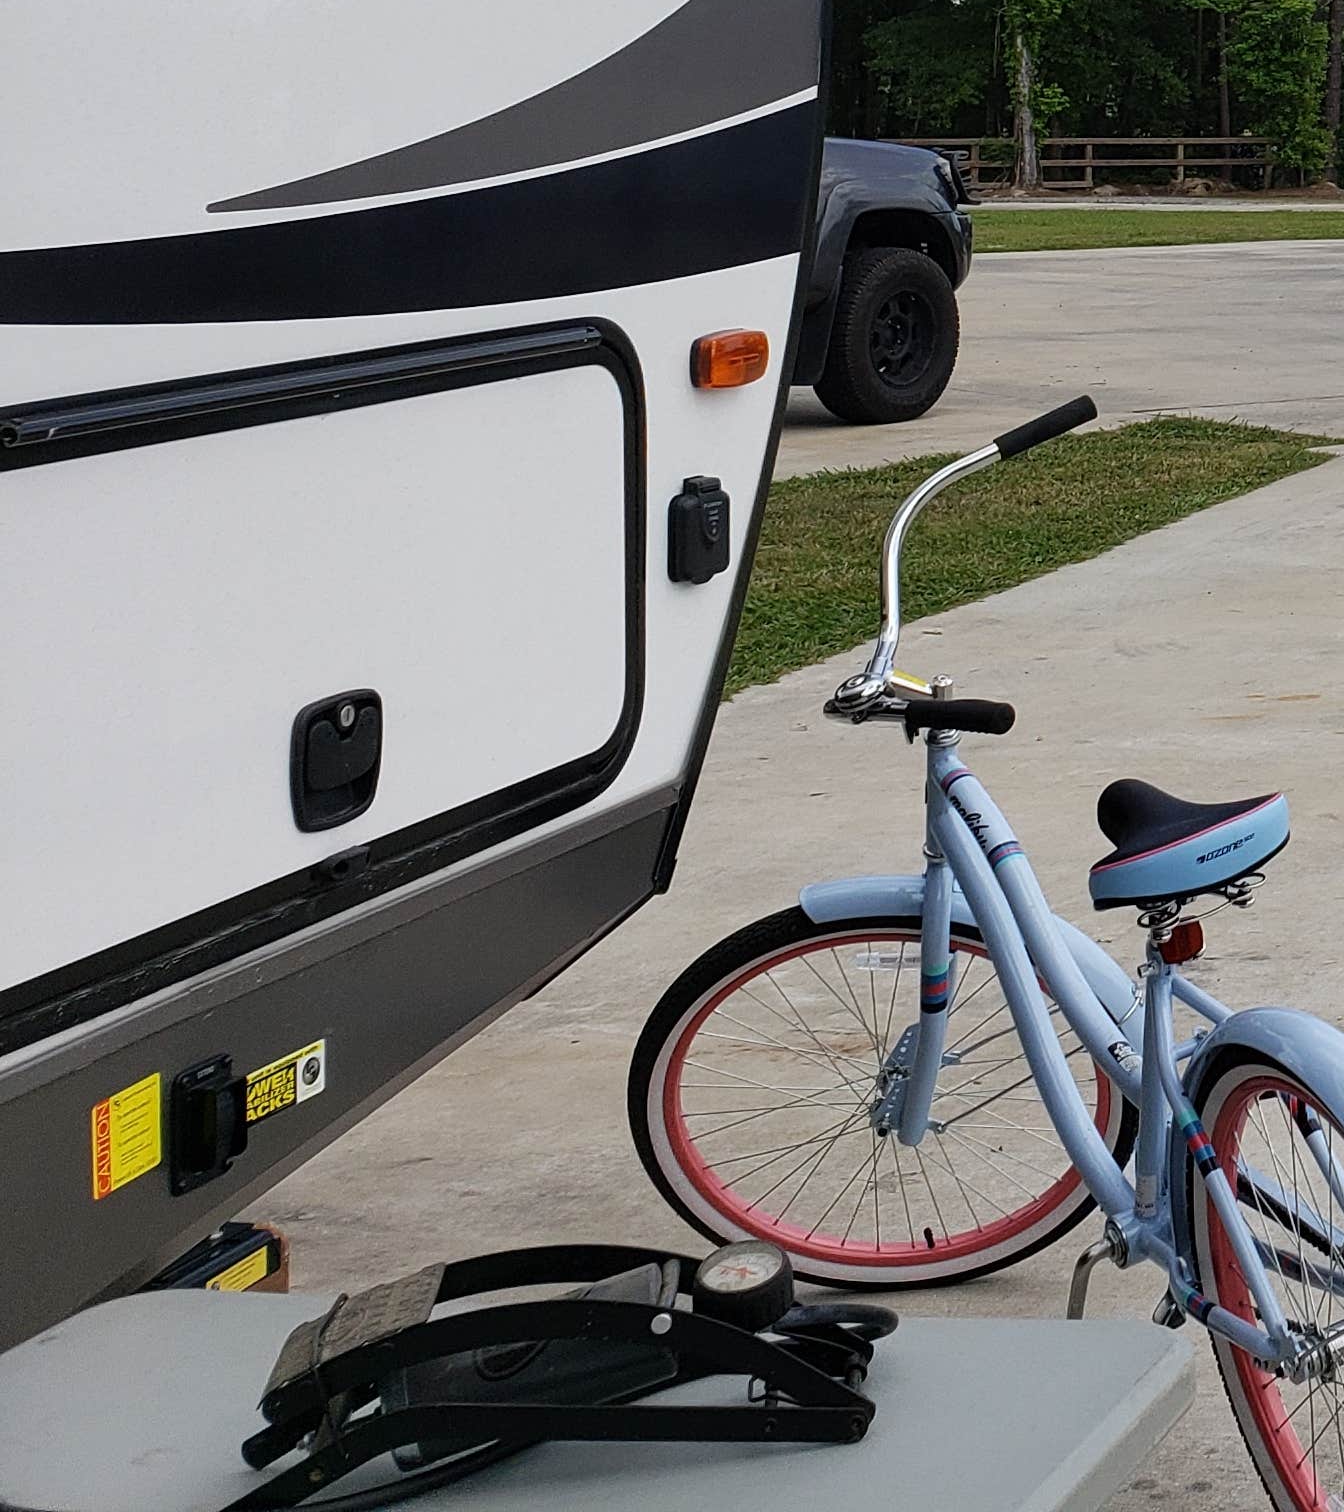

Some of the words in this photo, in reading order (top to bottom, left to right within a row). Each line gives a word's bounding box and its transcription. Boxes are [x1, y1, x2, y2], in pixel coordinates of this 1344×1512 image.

[247, 1067, 295, 1102] OWER
[247, 1089, 295, 1122] ACKS
[97, 1100, 111, 1193] CAUTION
